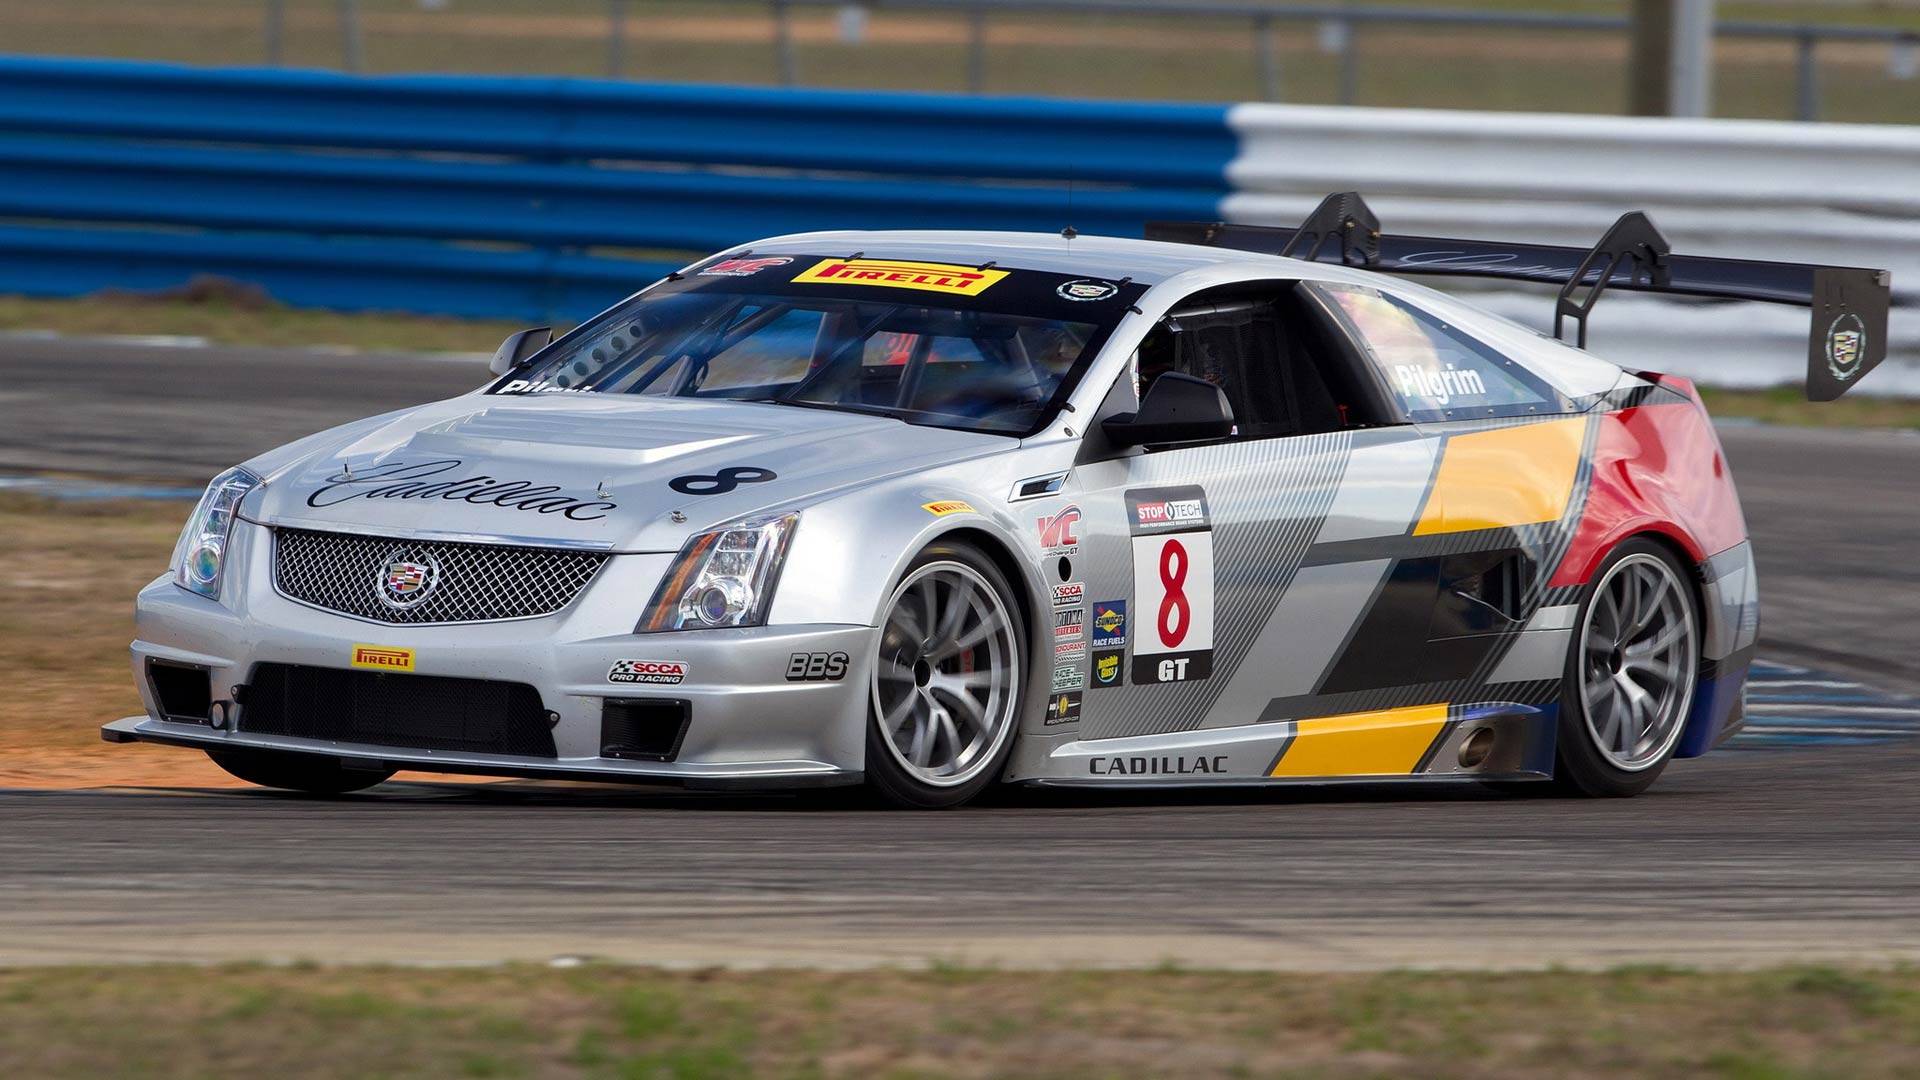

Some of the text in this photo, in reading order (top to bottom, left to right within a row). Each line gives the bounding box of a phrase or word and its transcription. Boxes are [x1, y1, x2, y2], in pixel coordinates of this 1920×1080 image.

[815, 264, 985, 288] PIRELLI
[1394, 363, 1486, 405] Pilgrim
[307, 460, 617, 521] Cadillac
[668, 467, 778, 495] 8
[1138, 503, 1201, 519] STOP TECH
[1037, 508, 1081, 548] WC
[1059, 586, 1082, 596] SCCA
[1158, 539, 1191, 648] 8
[1096, 615, 1123, 627] SUNOCO
[1093, 637, 1125, 647] RACE FUELS
[356, 648, 409, 666] PIRELLI
[785, 651, 849, 681] BBS
[611, 673, 681, 683] PRO RACING
[633, 662, 684, 674] SCCA
[1158, 658, 1189, 681] GT
[1089, 756, 1229, 775] CADILLAC
